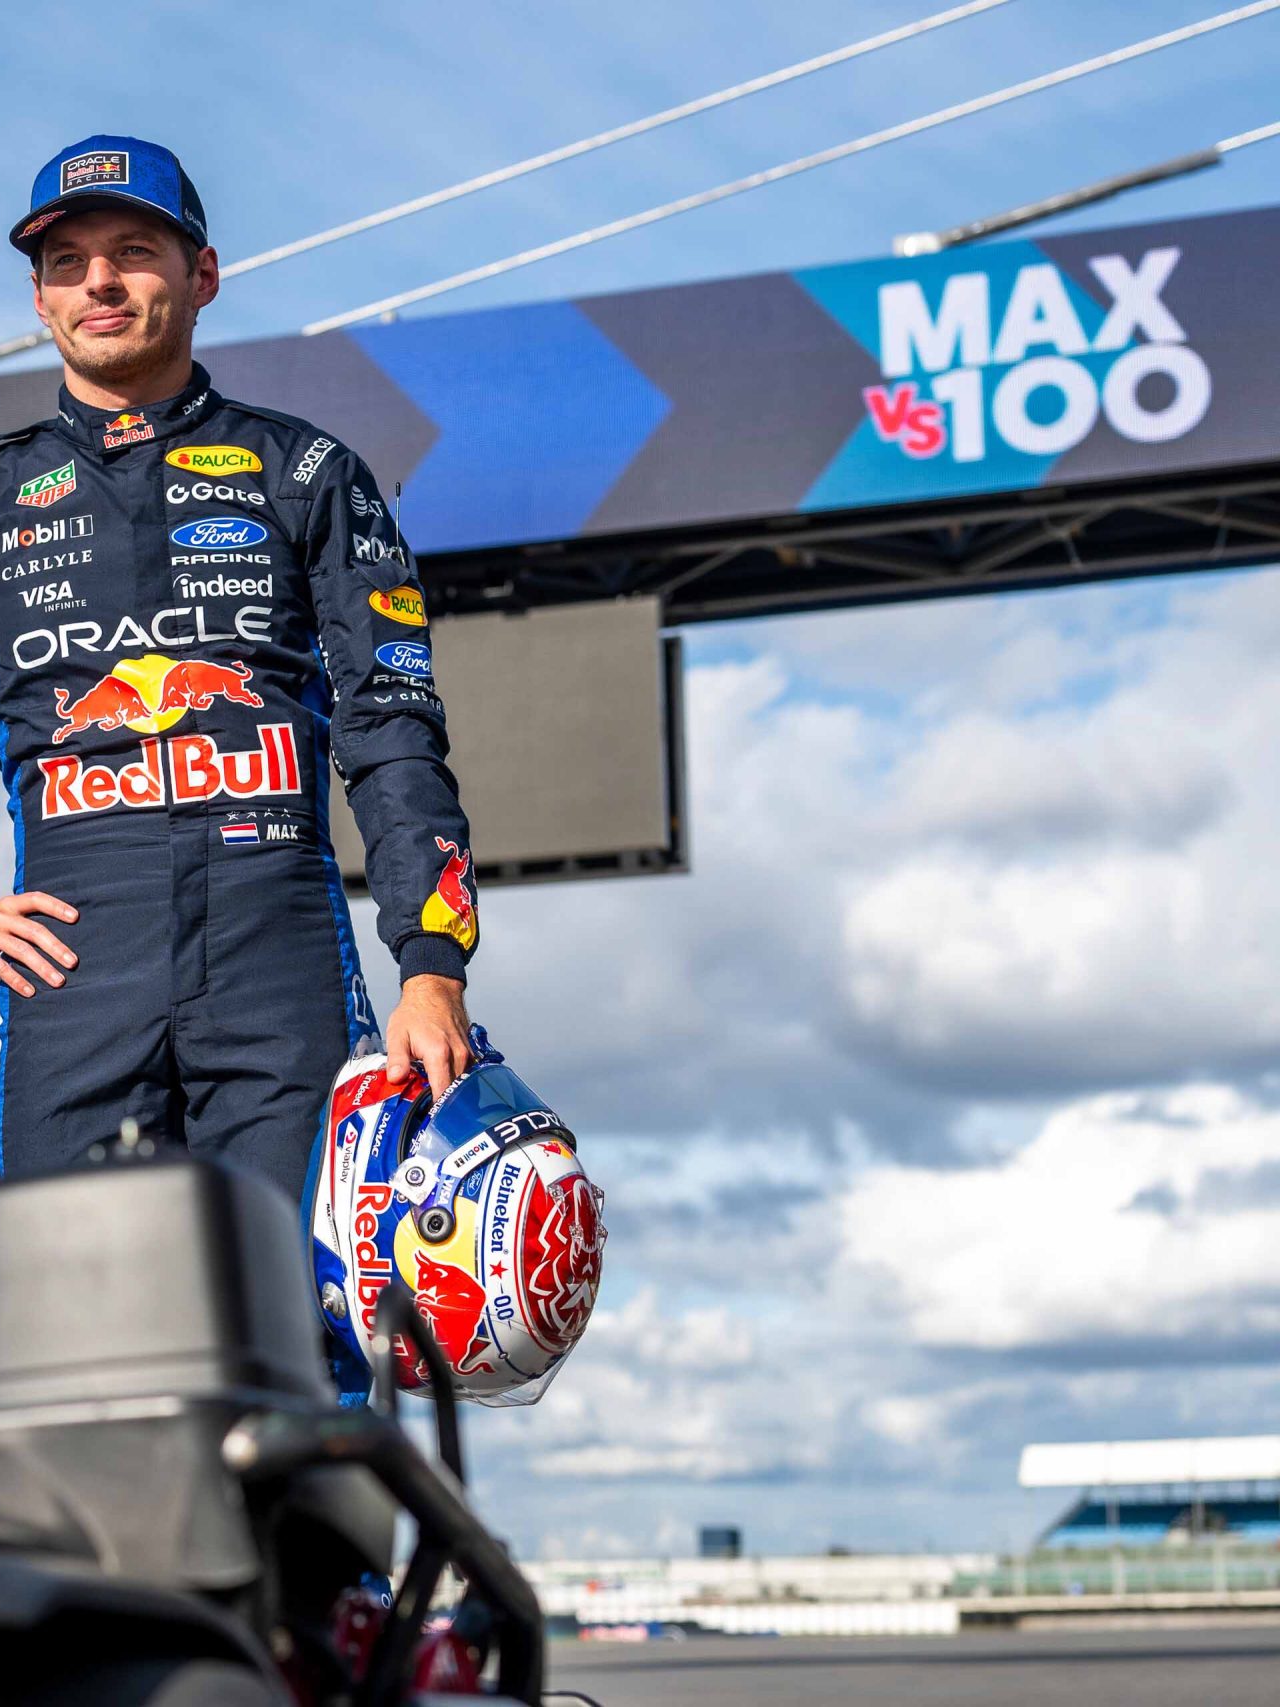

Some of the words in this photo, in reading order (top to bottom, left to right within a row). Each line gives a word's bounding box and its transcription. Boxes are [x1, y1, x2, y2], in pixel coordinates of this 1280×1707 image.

[68, 156, 120, 170] ORACLE
[67, 174, 120, 187] RACING
[877, 246, 1188, 379] MAX
[931, 342, 1212, 464] 100
[103, 431, 130, 449] Red
[129, 425, 155, 443] Bull
[193, 454, 252, 468] RAUCH
[20, 480, 76, 506] HEUER
[25, 469, 73, 495] TAG
[191, 482, 266, 506] Gate
[2, 522, 65, 553] Mobil
[190, 520, 249, 545] Ford
[2, 550, 92, 581] CARLYLE
[172, 554, 271, 565] RACING
[18, 581, 74, 608] VISA
[173, 573, 273, 598] indeed
[44, 599, 87, 613] INFINITE
[391, 596, 424, 616] RAUC
[12, 605, 273, 670] ORACLE
[391, 645, 431, 672] Ford
[38, 737, 165, 820] Red
[168, 722, 302, 804] Bull
[266, 824, 299, 840] MAX
[352, 1074, 377, 1106] indeed
[372, 1112, 391, 1158] DAMAC
[494, 1111, 561, 1144] ACLE
[464, 1140, 489, 1162] Mobil
[340, 1146, 352, 1183] viaplay
[437, 1178, 455, 1204] VISA
